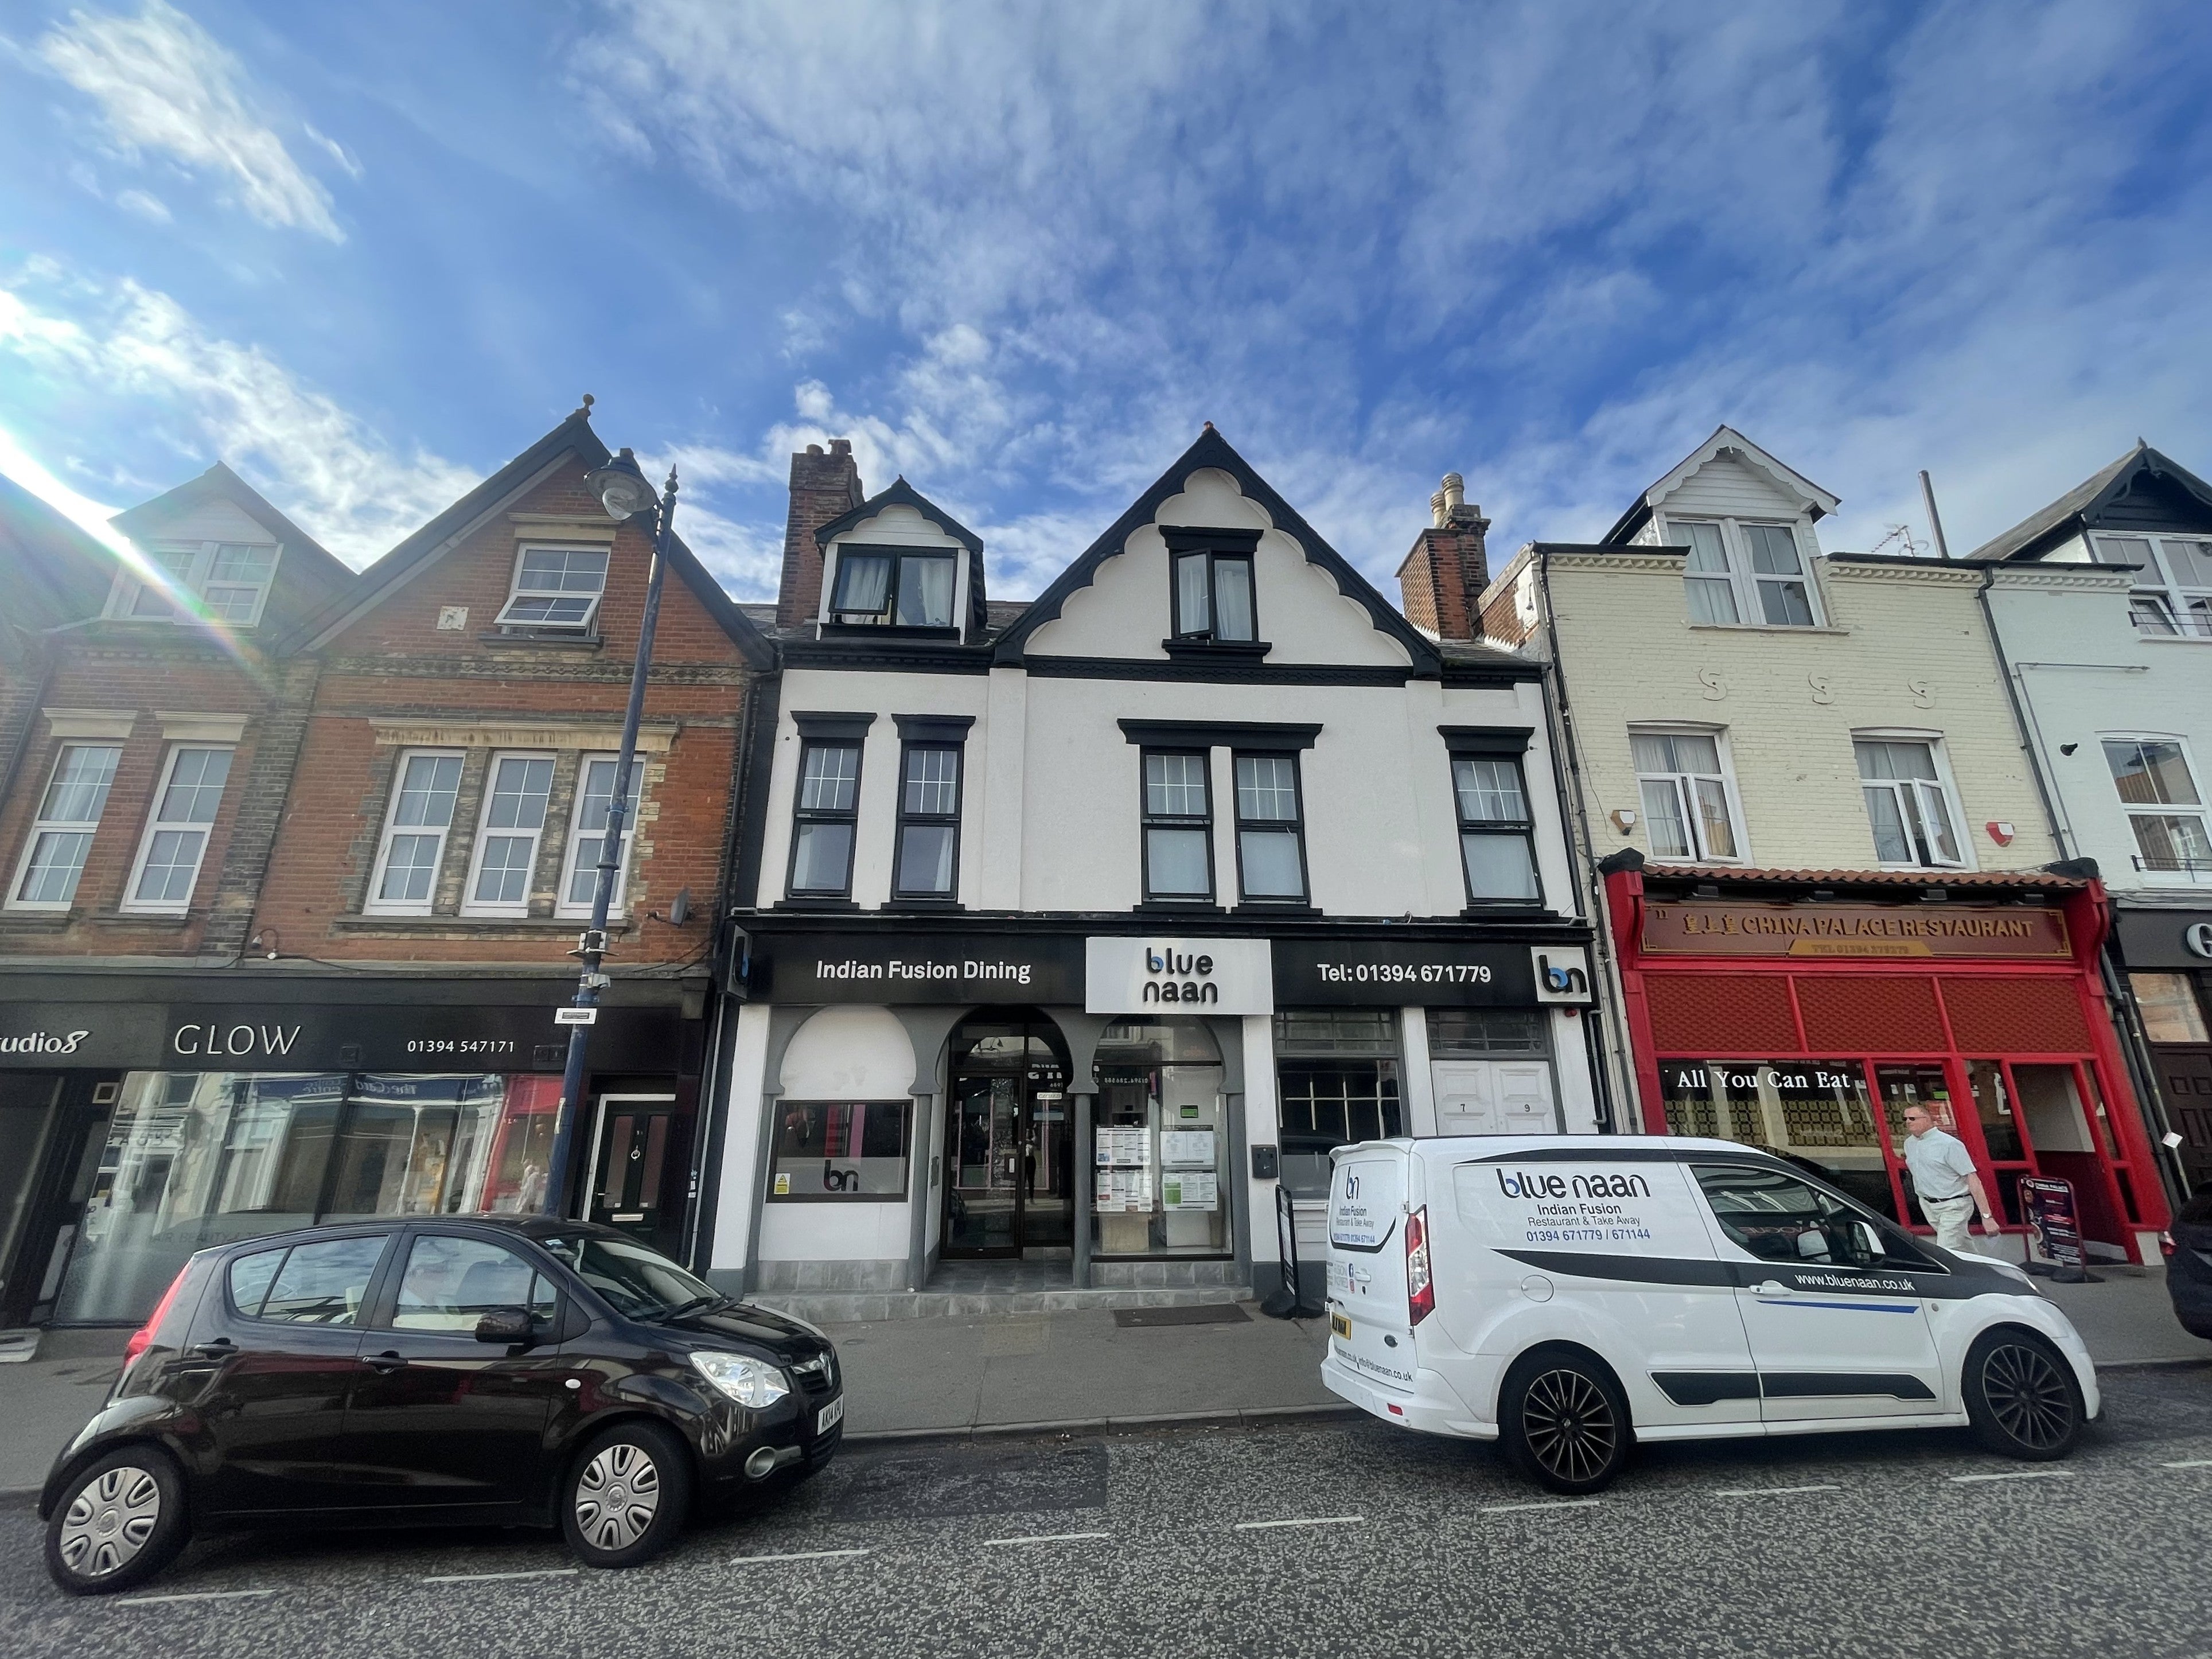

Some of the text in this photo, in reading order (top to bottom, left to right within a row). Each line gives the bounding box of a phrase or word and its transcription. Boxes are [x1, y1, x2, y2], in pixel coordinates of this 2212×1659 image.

[1741, 916, 2034, 937] CHINA PALACE RESTAURANT
[1146, 947, 1214, 976] blue
[816, 960, 1031, 984] Indian Fusion Dining
[1317, 964, 1491, 983] Tel: 01394 671779
[1539, 955, 1587, 994] bn
[1143, 981, 1218, 1003] naan
[174, 1024, 302, 1056] GLOW
[407, 1040, 514, 1052] 01394 547171
[1677, 1069, 1851, 1088] All You Can Eat
[1460, 1104, 1466, 1112] 7
[1524, 1104, 1531, 1112] 9
[823, 1159, 859, 1191] bn
[1496, 1169, 1651, 1199] blue naan
[1350, 1206, 1367, 1217] Fusion
[1537, 1202, 1622, 1215] Indian Fusion
[1528, 1216, 1640, 1227] Restaurant & Take Away
[1526, 1230, 1559, 1241] 01394
[1563, 1229, 1603, 1241] 671779
[1613, 1228, 1651, 1240] 671144
[1794, 1274, 1916, 1291] www.bluenaan.co.uk
